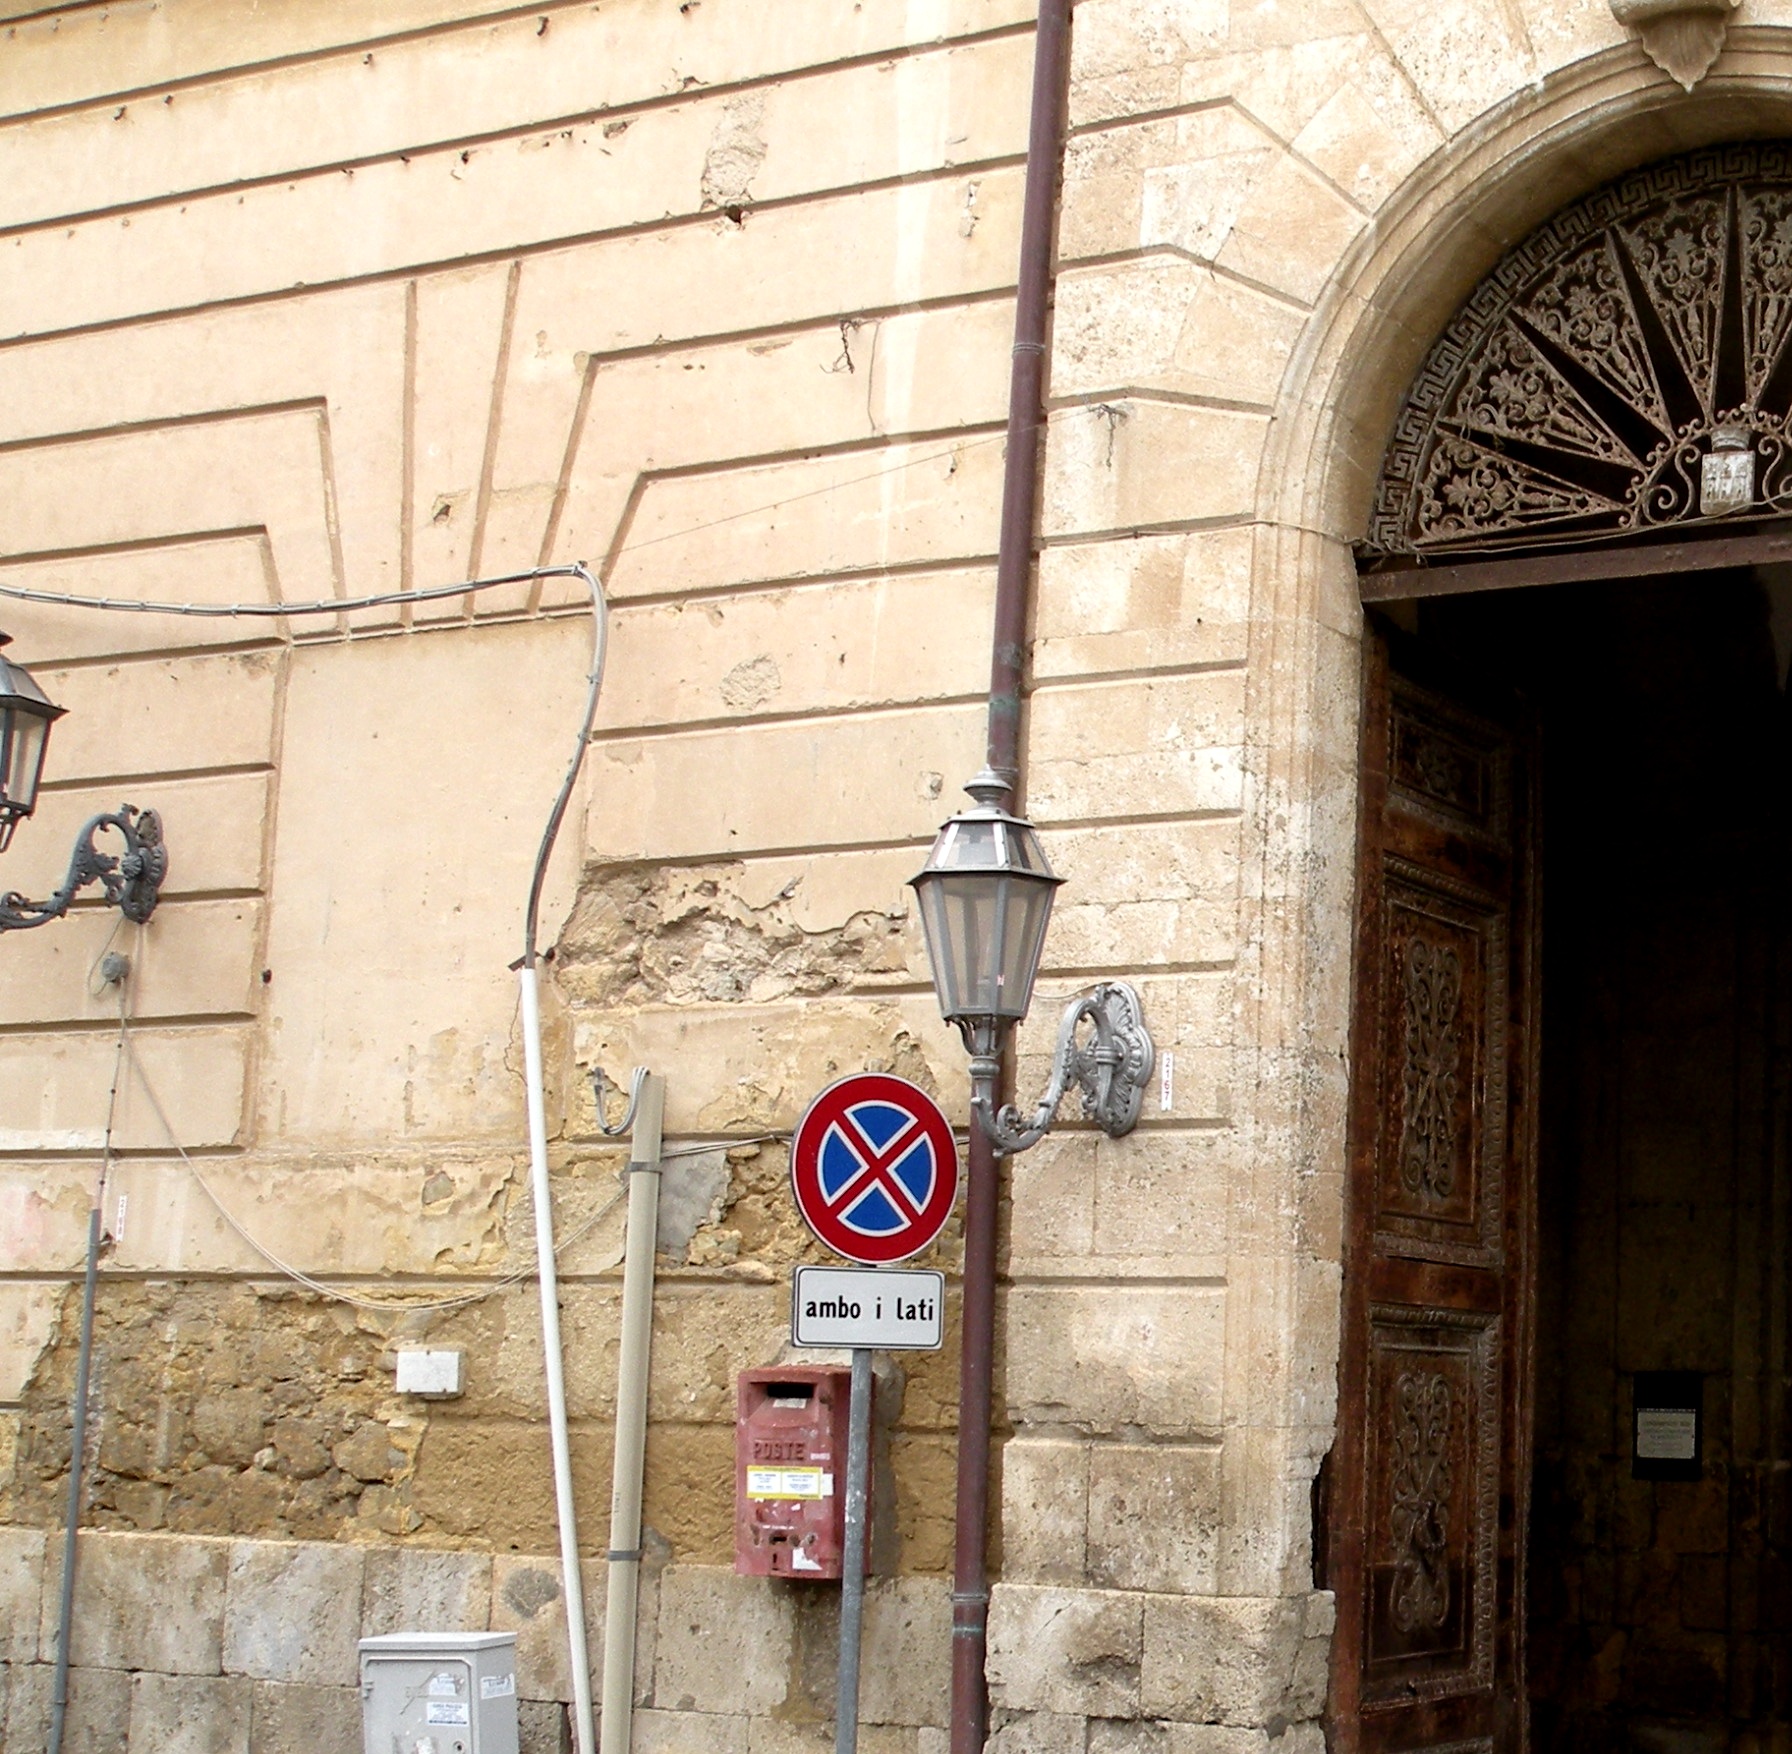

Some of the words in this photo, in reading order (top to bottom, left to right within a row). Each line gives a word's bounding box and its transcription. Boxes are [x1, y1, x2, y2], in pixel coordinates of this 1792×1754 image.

[806, 1295, 861, 1319] ambo
[876, 1297, 882, 1320] i
[896, 1297, 934, 1321] lati
[754, 1441, 805, 1461] POSTE
